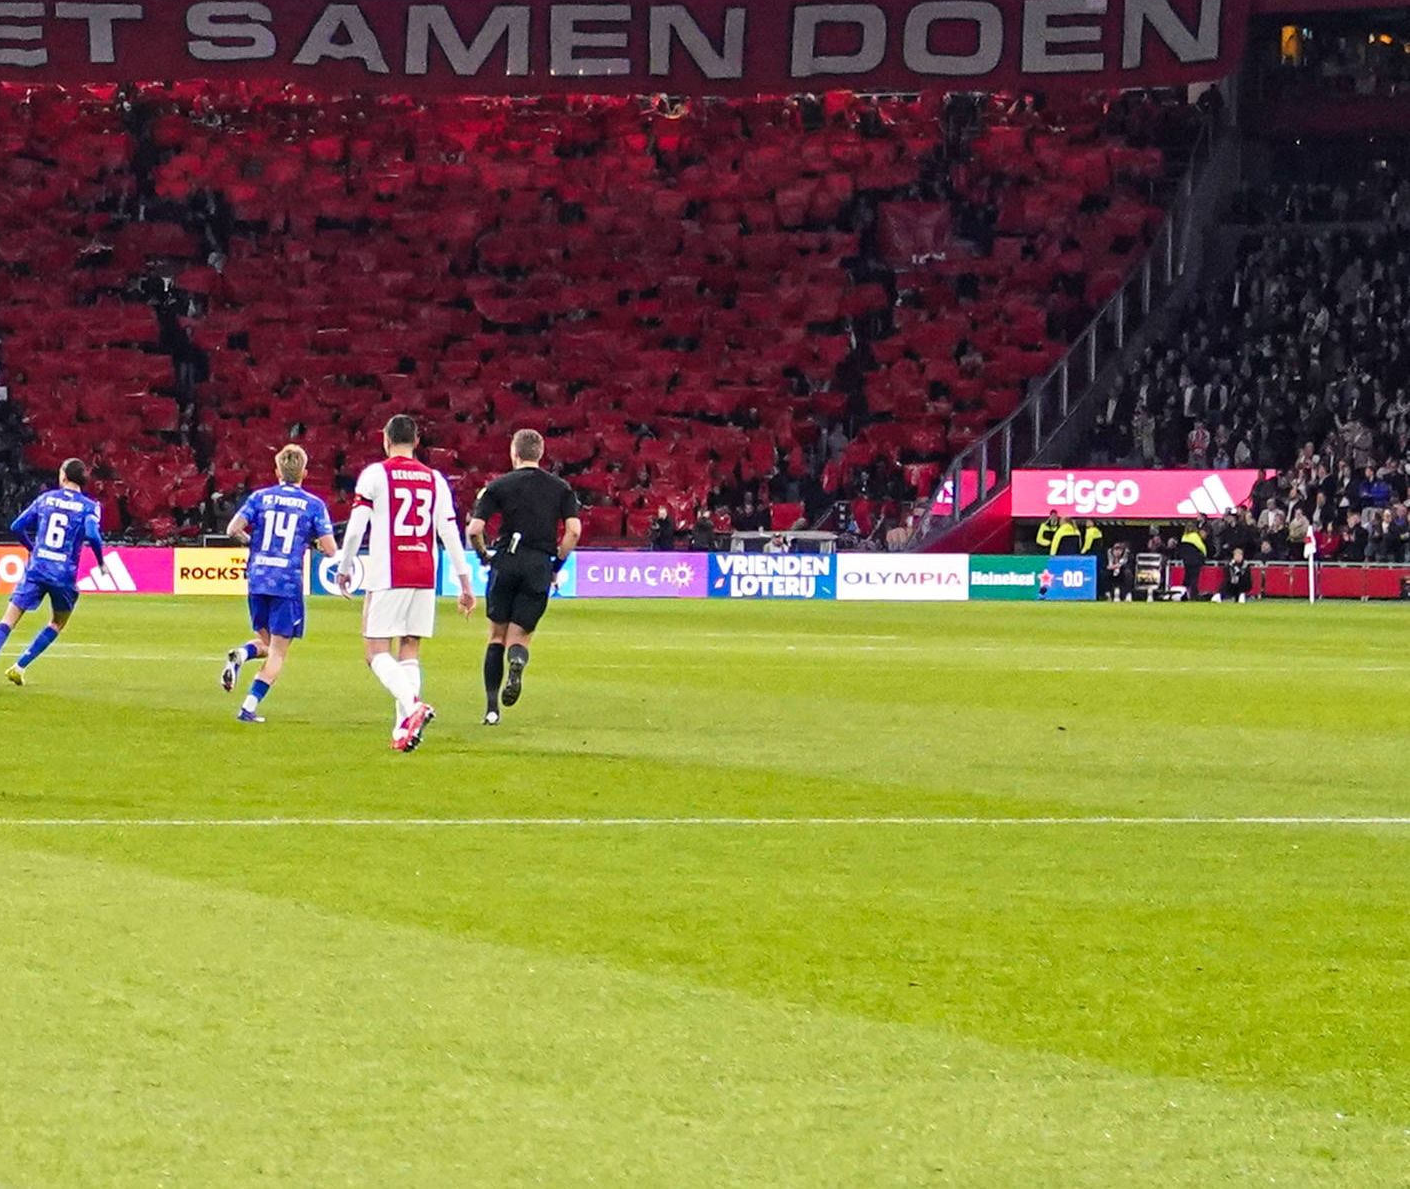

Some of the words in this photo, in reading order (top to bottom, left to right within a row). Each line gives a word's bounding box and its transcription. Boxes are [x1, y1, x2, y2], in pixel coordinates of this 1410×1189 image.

[185, 0, 747, 79] SAMEN
[1047, 472, 1140, 514] ziggo
[45, 512, 69, 549] 6
[393, 487, 433, 537] 23
[261, 510, 299, 555] 14
[716, 554, 830, 576] VRIENDEN
[843, 571, 962, 586] OLYMPIA
[970, 570, 1036, 586] Heineken
[731, 576, 816, 598] LOTERIJ
